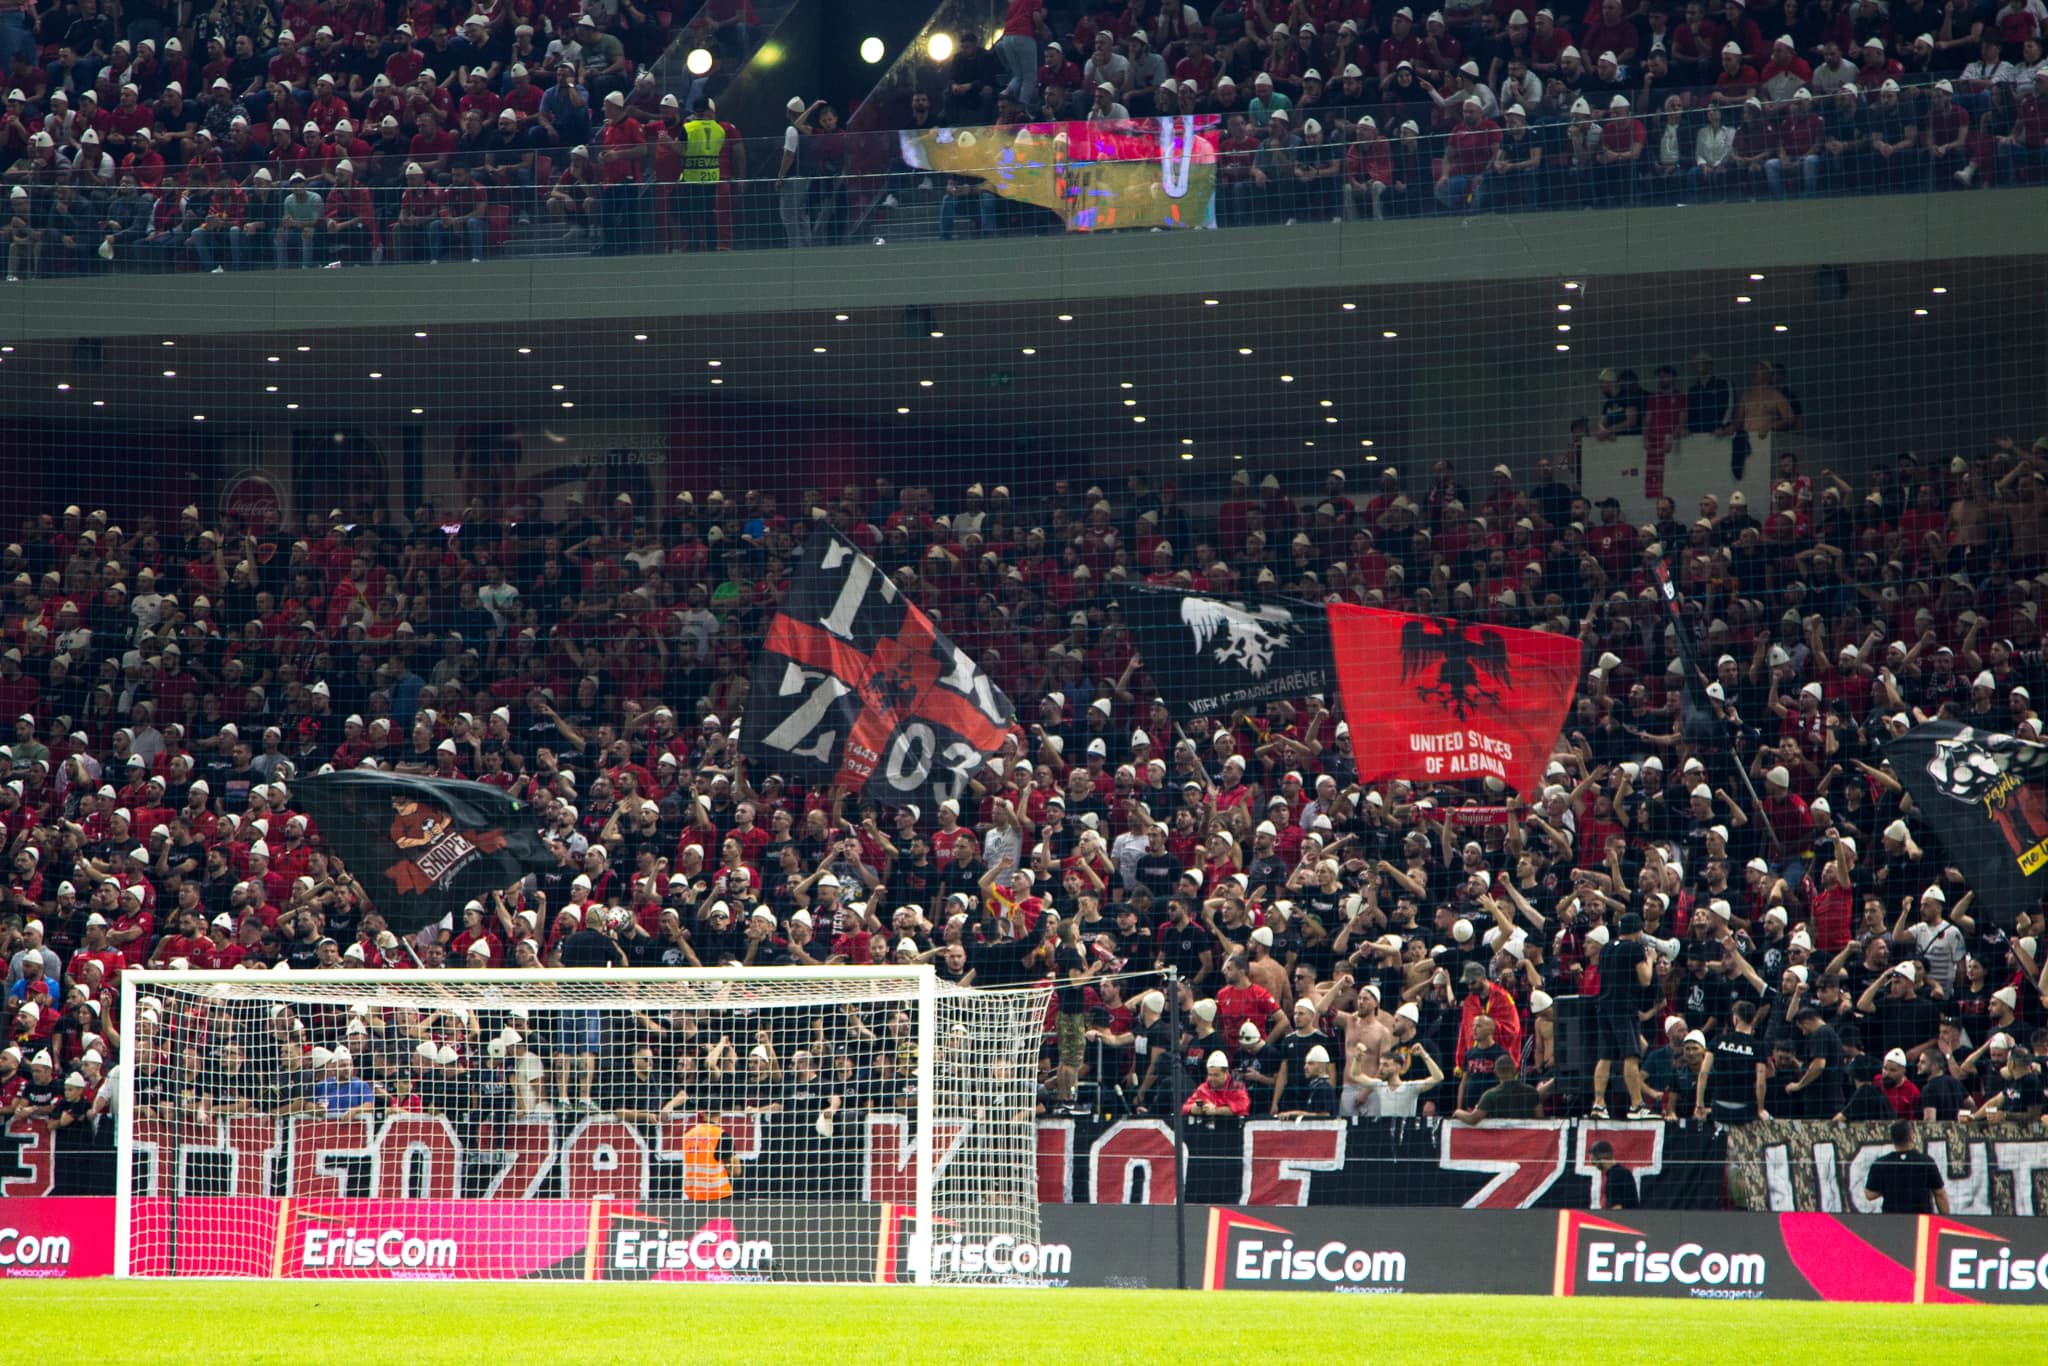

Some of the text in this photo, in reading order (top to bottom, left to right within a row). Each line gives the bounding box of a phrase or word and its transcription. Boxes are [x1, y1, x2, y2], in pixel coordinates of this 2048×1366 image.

[1410, 731, 1463, 753] UNITED
[1425, 757, 1445, 775] OF
[302, 1228, 458, 1267] ErisCom
[615, 1229, 773, 1270] ErisCom
[1236, 1238, 1407, 1282] ErisCom
[1587, 1240, 1766, 1285] ErisCom
[1691, 1286, 1764, 1300] Mediaagentur
